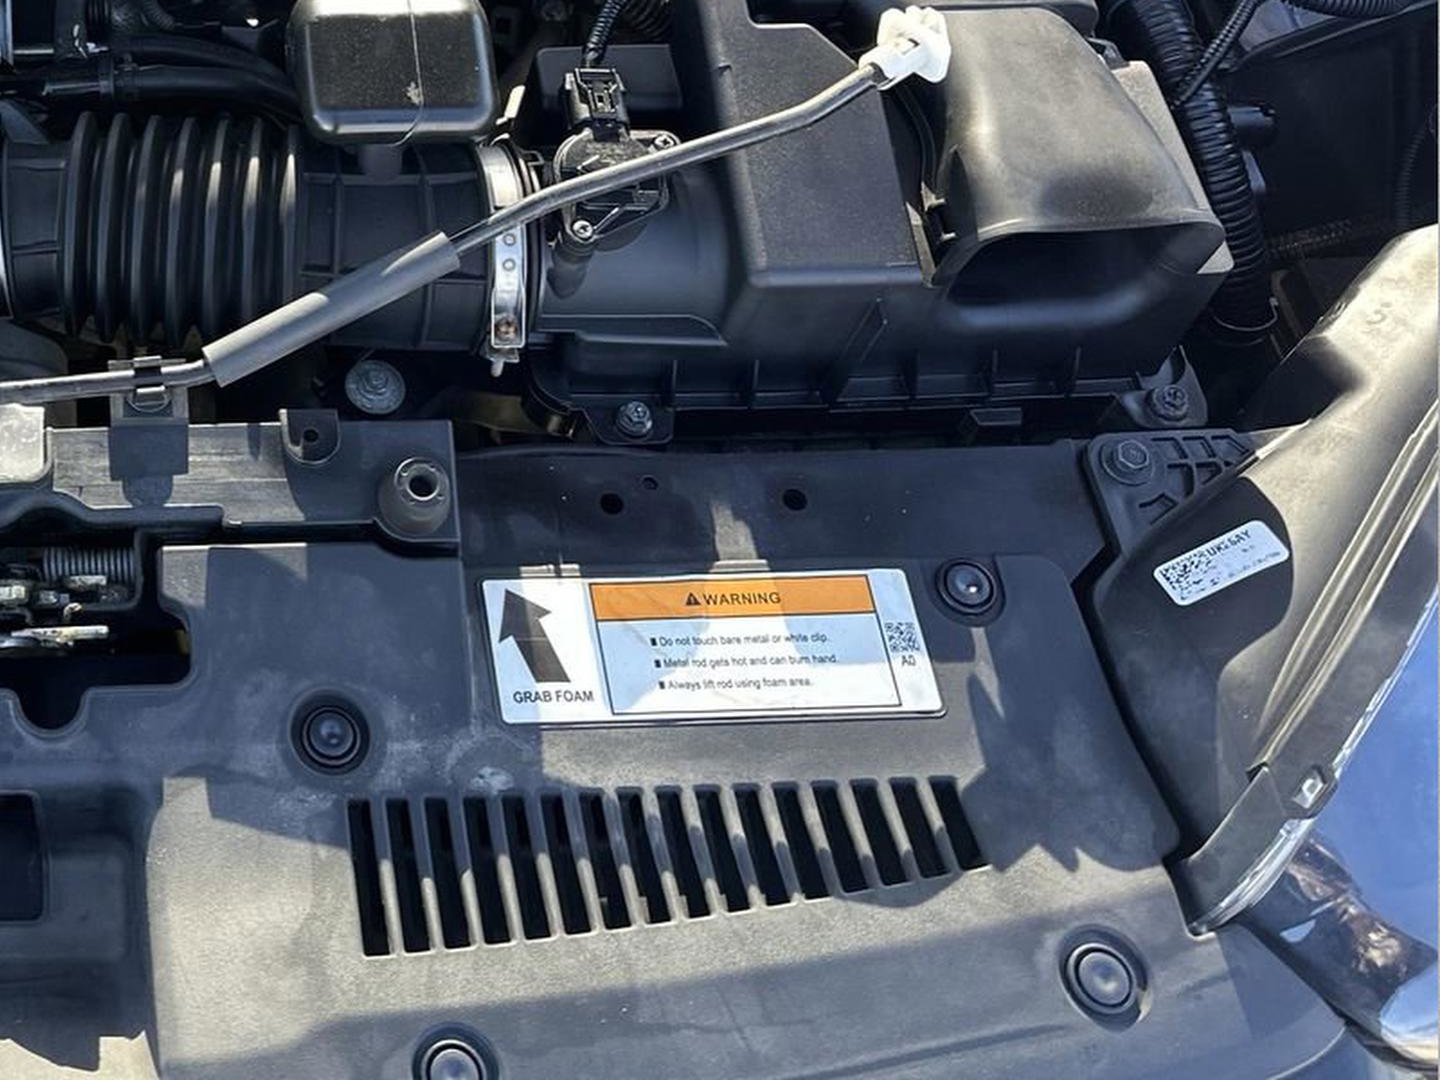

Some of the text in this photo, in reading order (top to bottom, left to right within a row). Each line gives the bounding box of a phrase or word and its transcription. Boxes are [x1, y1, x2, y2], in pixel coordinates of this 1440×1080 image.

[702, 591, 782, 607] WARNING
[659, 632, 830, 647] Do not touch bare metal or white clip.
[663, 654, 839, 669] Metal rod gets hot and can burn hand.
[667, 677, 815, 692] Always lift rod using foam area.
[513, 689, 595, 704] GRAB FOAM
